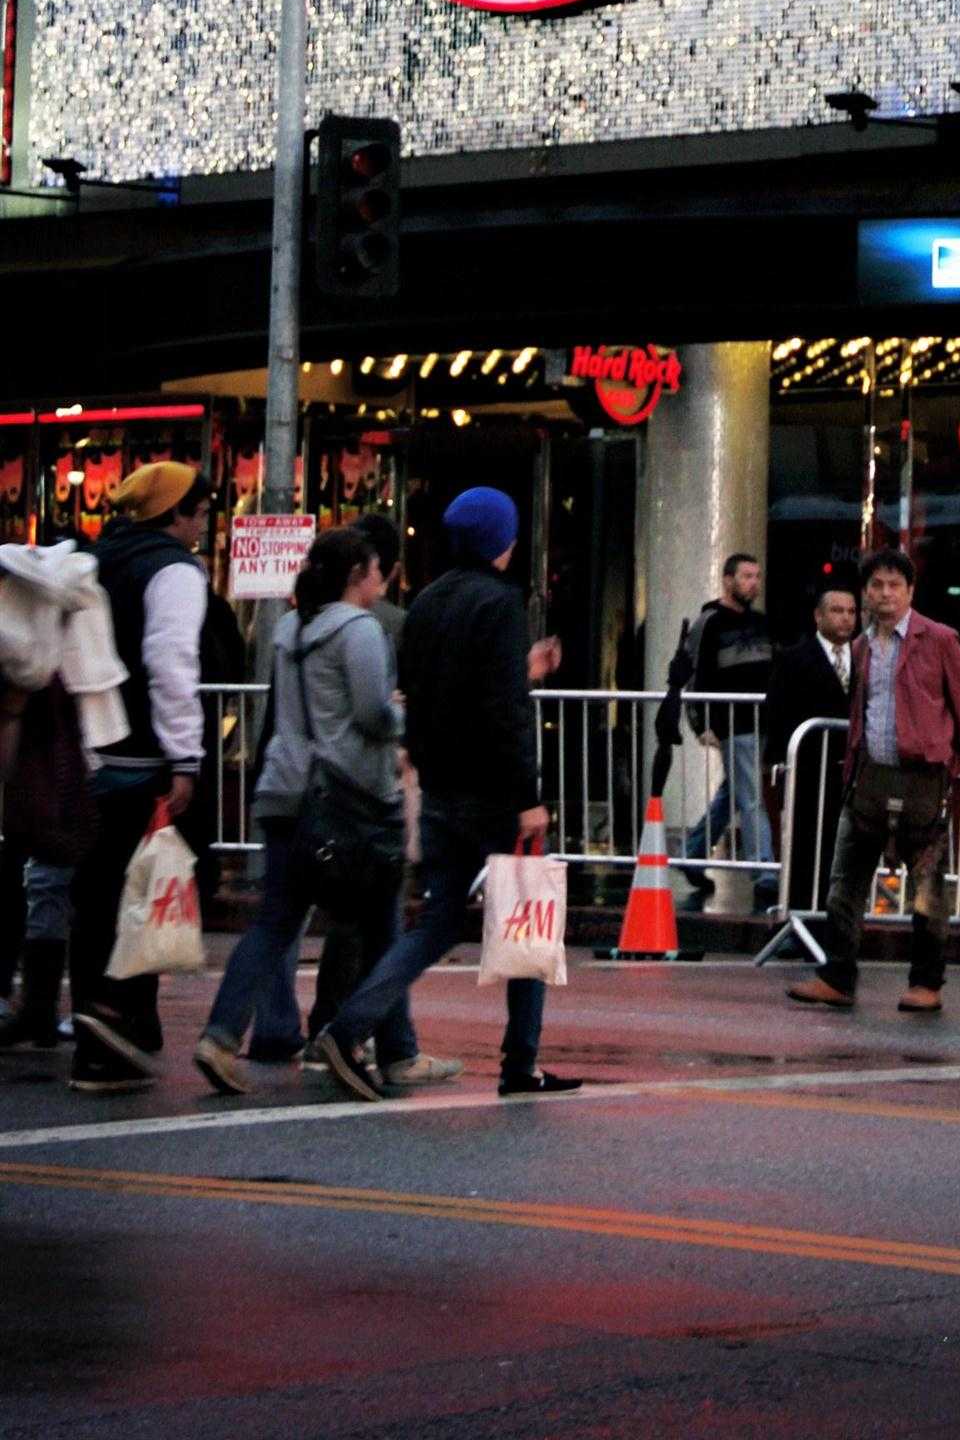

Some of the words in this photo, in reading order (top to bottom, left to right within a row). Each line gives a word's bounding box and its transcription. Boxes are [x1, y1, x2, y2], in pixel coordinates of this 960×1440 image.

[571, 345, 629, 380] Hard
[235, 538, 259, 557] NO
[239, 559, 267, 573] ANY
